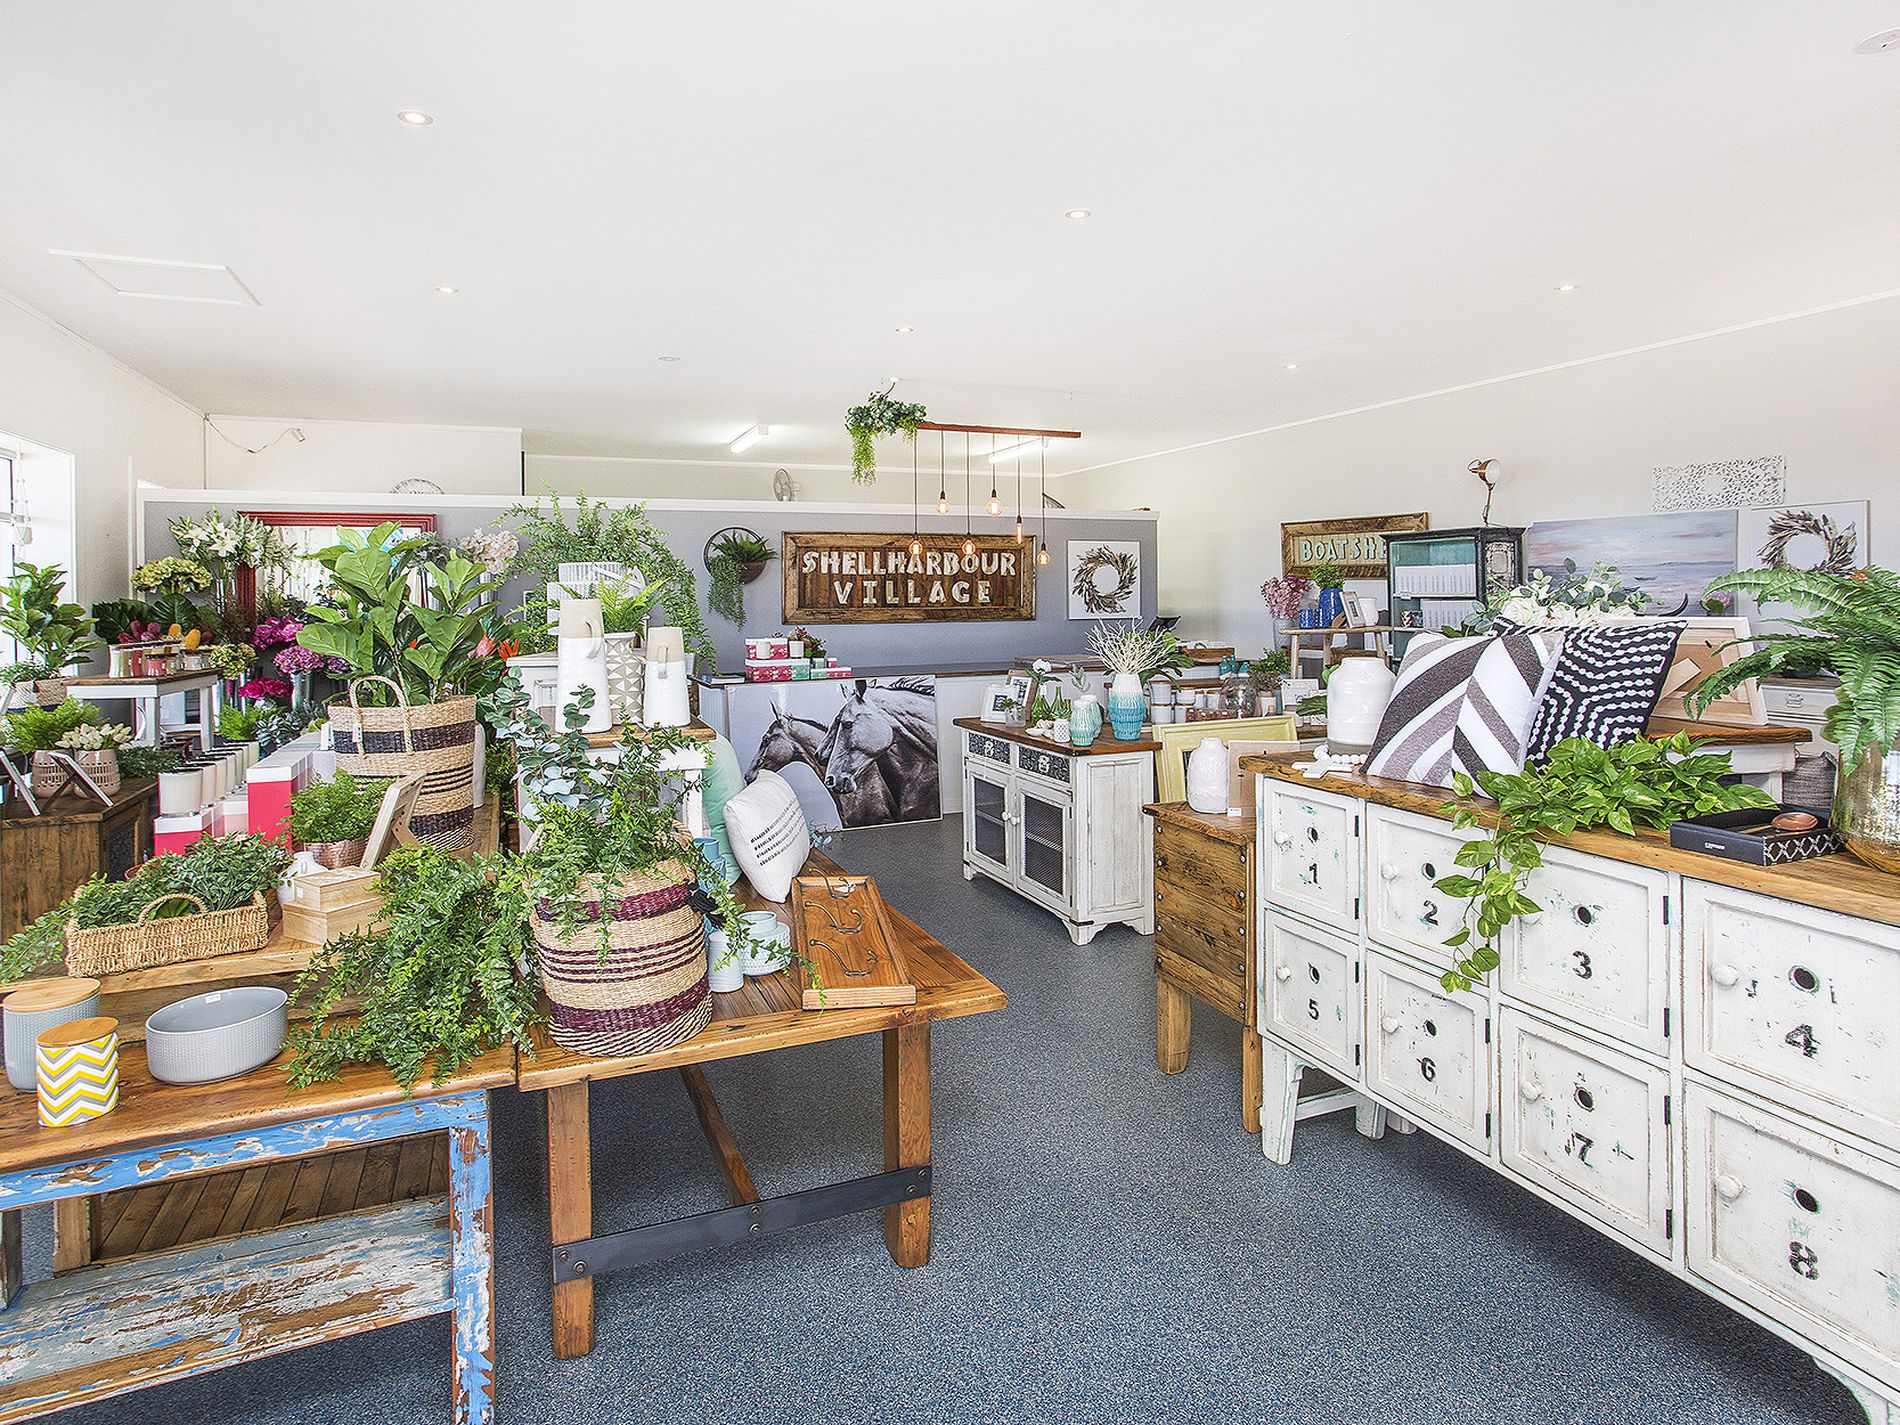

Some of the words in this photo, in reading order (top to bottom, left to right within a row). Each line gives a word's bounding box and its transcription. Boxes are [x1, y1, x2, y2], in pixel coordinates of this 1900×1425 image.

[802, 551, 1016, 576] SHELLHARBOUR
[833, 580, 991, 605] VILLAGE
[1309, 863, 1318, 885] 1
[1423, 900, 1439, 926] 2
[1572, 950, 1593, 980] 3
[1308, 999, 1320, 1021] 5
[1785, 1023, 1819, 1059] 4
[1419, 1056, 1437, 1083] 6
[1570, 1131, 1595, 1169] 7
[1788, 1240, 1820, 1281] 8
